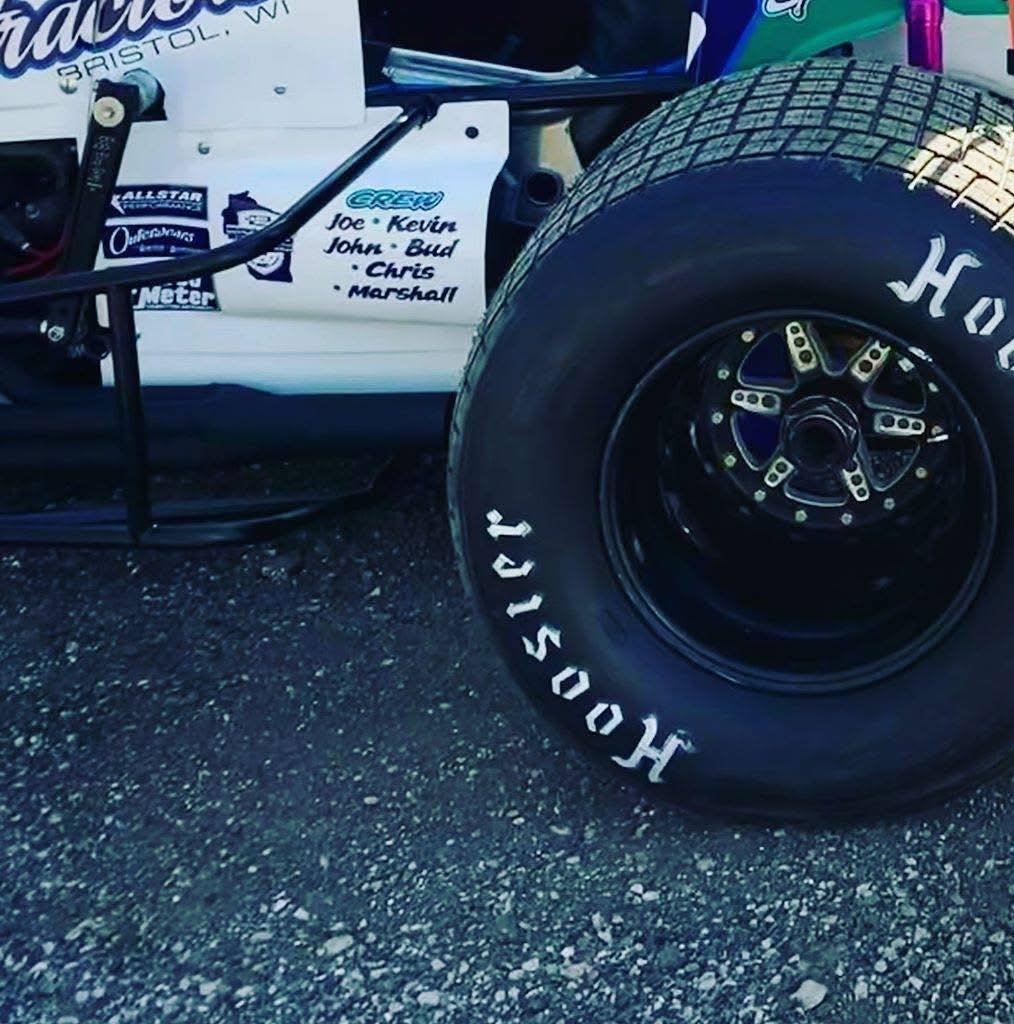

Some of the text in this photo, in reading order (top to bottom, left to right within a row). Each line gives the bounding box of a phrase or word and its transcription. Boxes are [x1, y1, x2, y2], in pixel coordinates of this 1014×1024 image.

[57, 0, 290, 80] BRISTOL, WI
[121, 190, 203, 202] ALLSTAR
[346, 189, 444, 211] CREW
[326, 213, 457, 234] Joe Kevin
[323, 236, 460, 258] John Bud
[365, 261, 435, 280] Chris
[133, 285, 216, 310] Meter
[348, 285, 458, 303] Marshall
[486, 508, 696, 785] Hoosier
